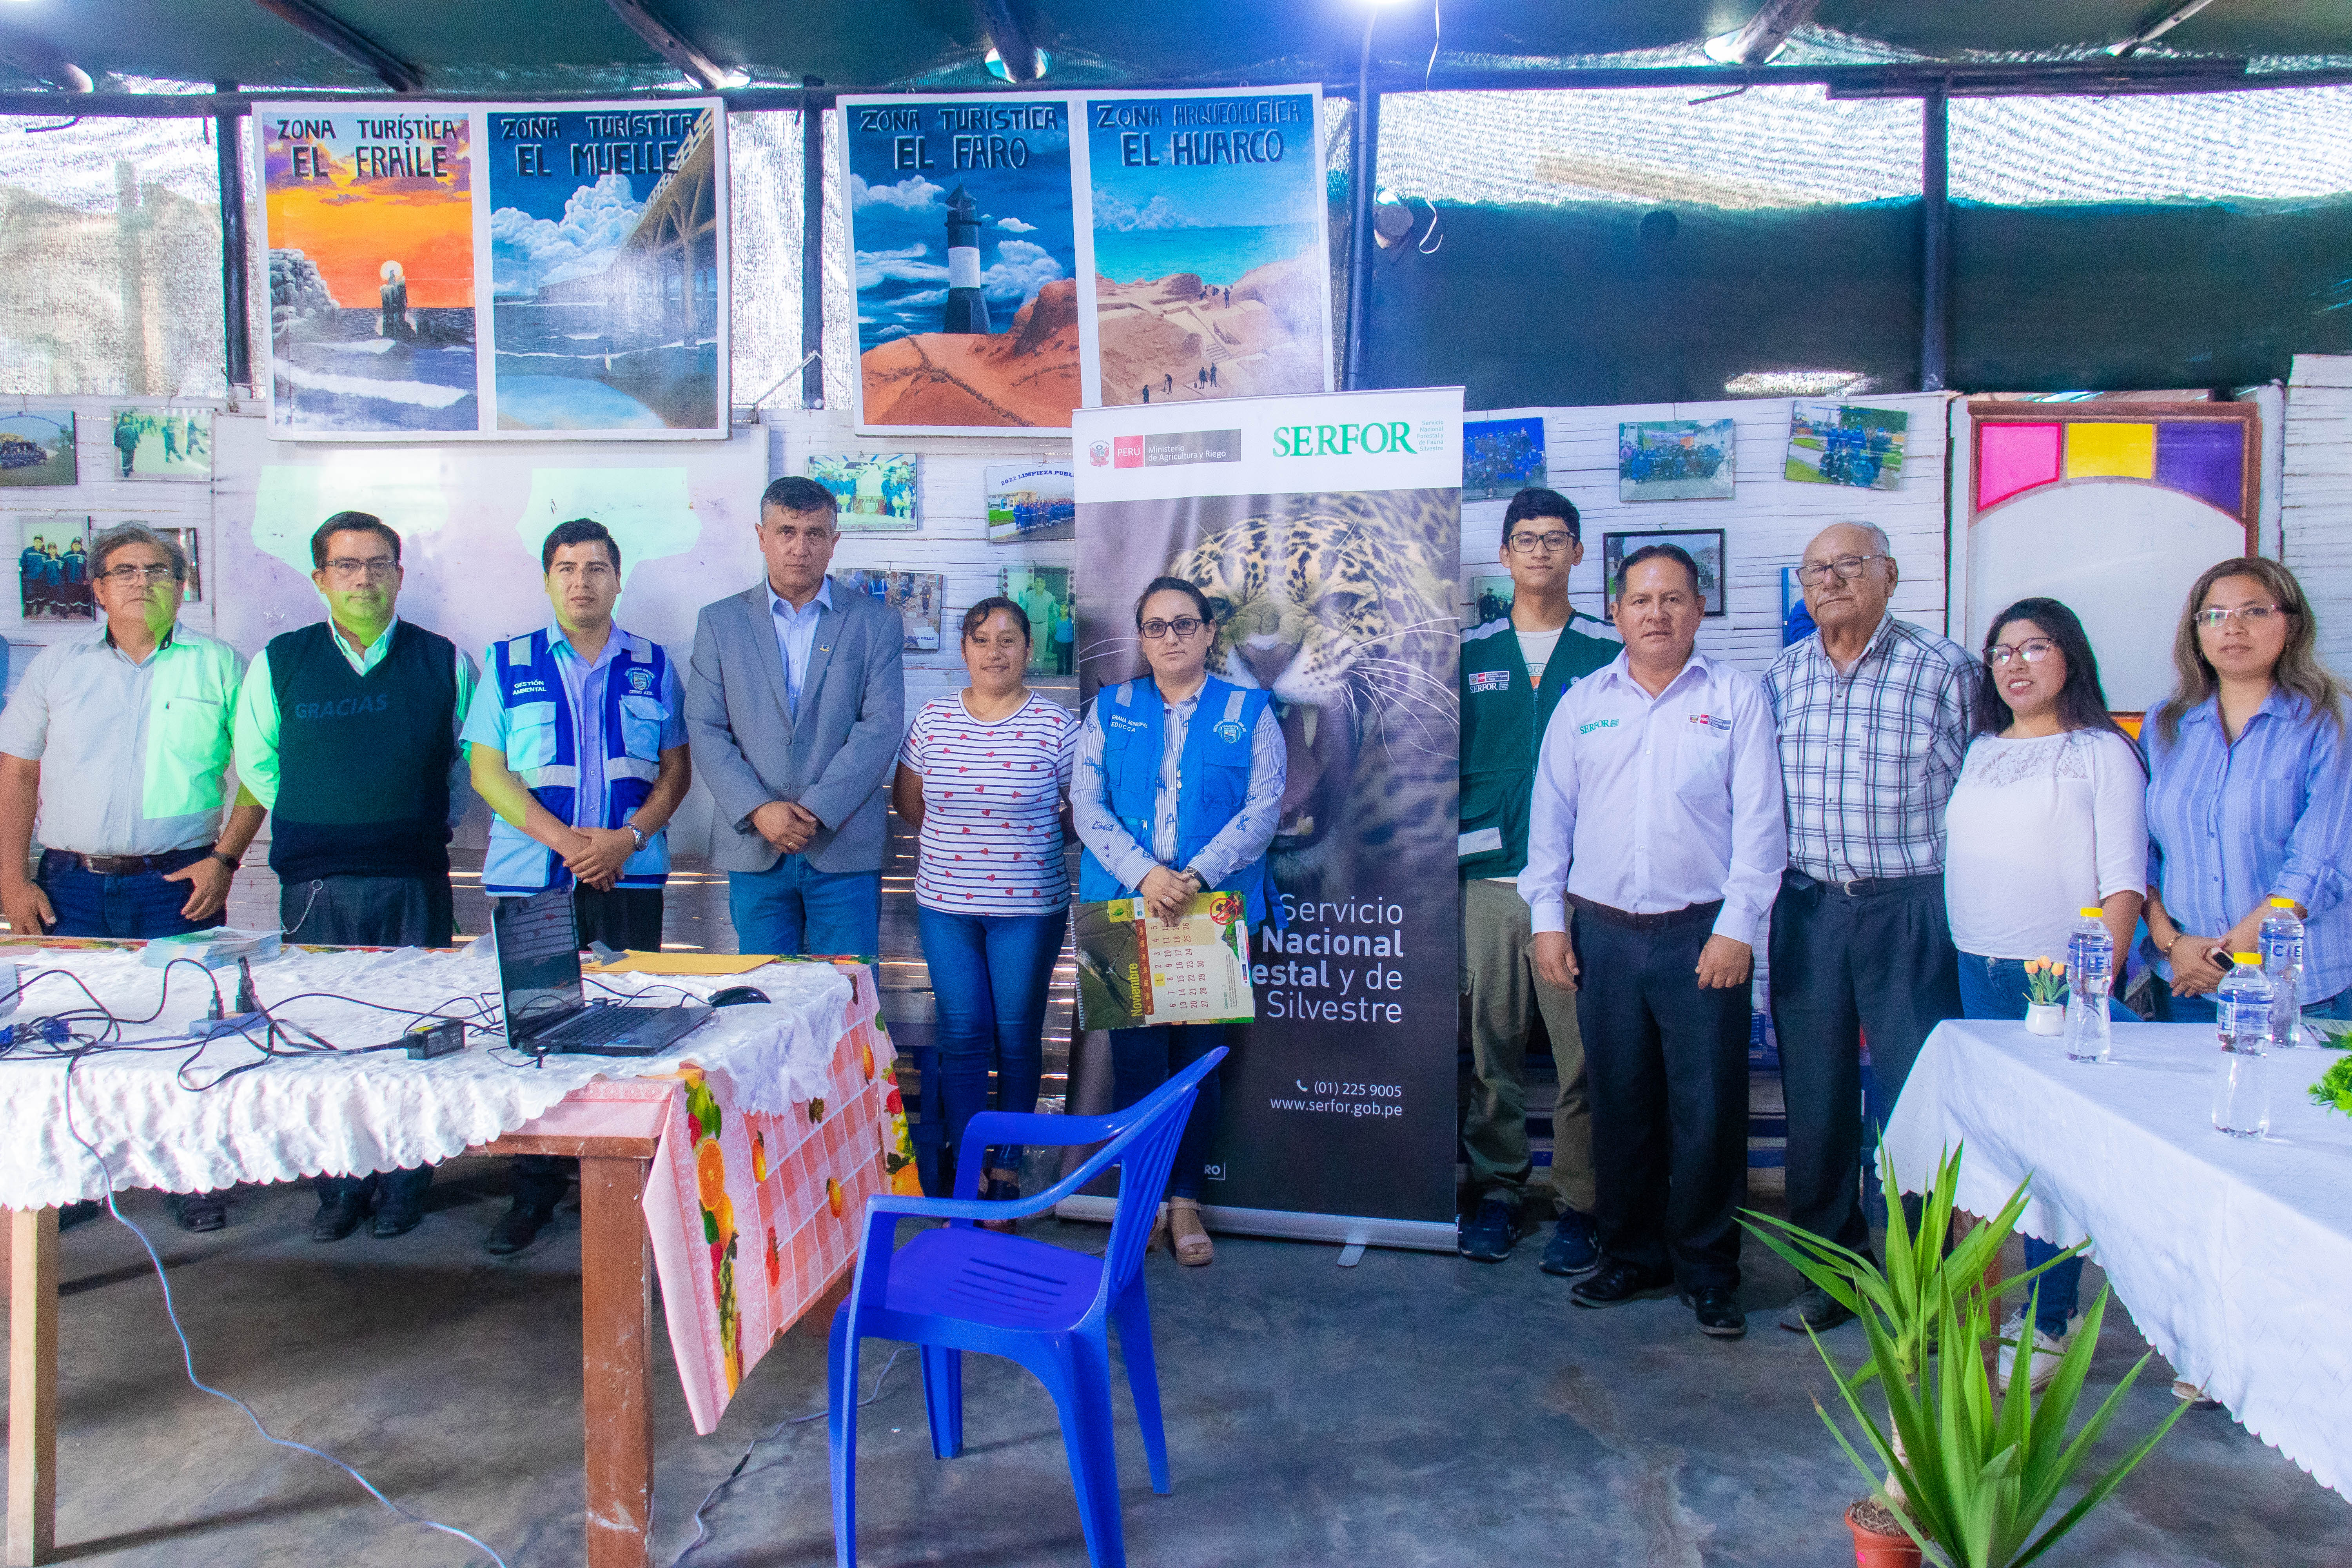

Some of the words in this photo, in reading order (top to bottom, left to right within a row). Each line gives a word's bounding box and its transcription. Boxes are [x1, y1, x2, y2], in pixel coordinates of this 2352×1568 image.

[860, 109, 920, 132] ZONA
[941, 104, 1058, 130] TURÍSTICA
[1097, 105, 1162, 128] ZONA
[277, 118, 335, 140] ZONA
[501, 117, 561, 140] ZONA
[292, 144, 329, 177] EL
[356, 139, 448, 178] FRAILE
[516, 143, 552, 176] EL
[571, 141, 680, 176] MUELLE
[894, 136, 934, 170] EL
[953, 136, 1029, 169] FARO
[1122, 132, 1159, 167] EL
[1171, 129, 1284, 166] HUARCO
[1117, 446, 1140, 457] PERÚ
[1273, 422, 1418, 458] SERFOR
[1159, 453, 1197, 463] Agricultura
[1205, 450, 1226, 459] Riego
[1001, 476, 1017, 486] 2022
[1018, 470, 1053, 479] LIMPIEZA
[513, 687, 546, 695] AMBIENTAL
[514, 679, 544, 688] GESTIÓN
[1470, 682, 1499, 693] SERFOR
[296, 694, 389, 719] GRACIAS
[1111, 722, 1135, 732] EDUCCA
[1127, 720, 1148, 729] MUNICIPAL
[1580, 720, 1610, 734] SERFOR
[1279, 893, 1403, 924] Servicio
[1262, 926, 1404, 957] Nacional
[1252, 960, 1330, 987] estal
[1339, 969, 1355, 996] y
[1366, 962, 1402, 990] de
[1127, 963, 1143, 1017] Noviembre
[1267, 991, 1402, 1023] Silvestre
[1314, 1081, 1338, 1096] (01)
[1342, 1083, 1366, 1096] 225
[1370, 1085, 1402, 1098] 9005
[1270, 1098, 1403, 1118] www.serfor.gob.pe
